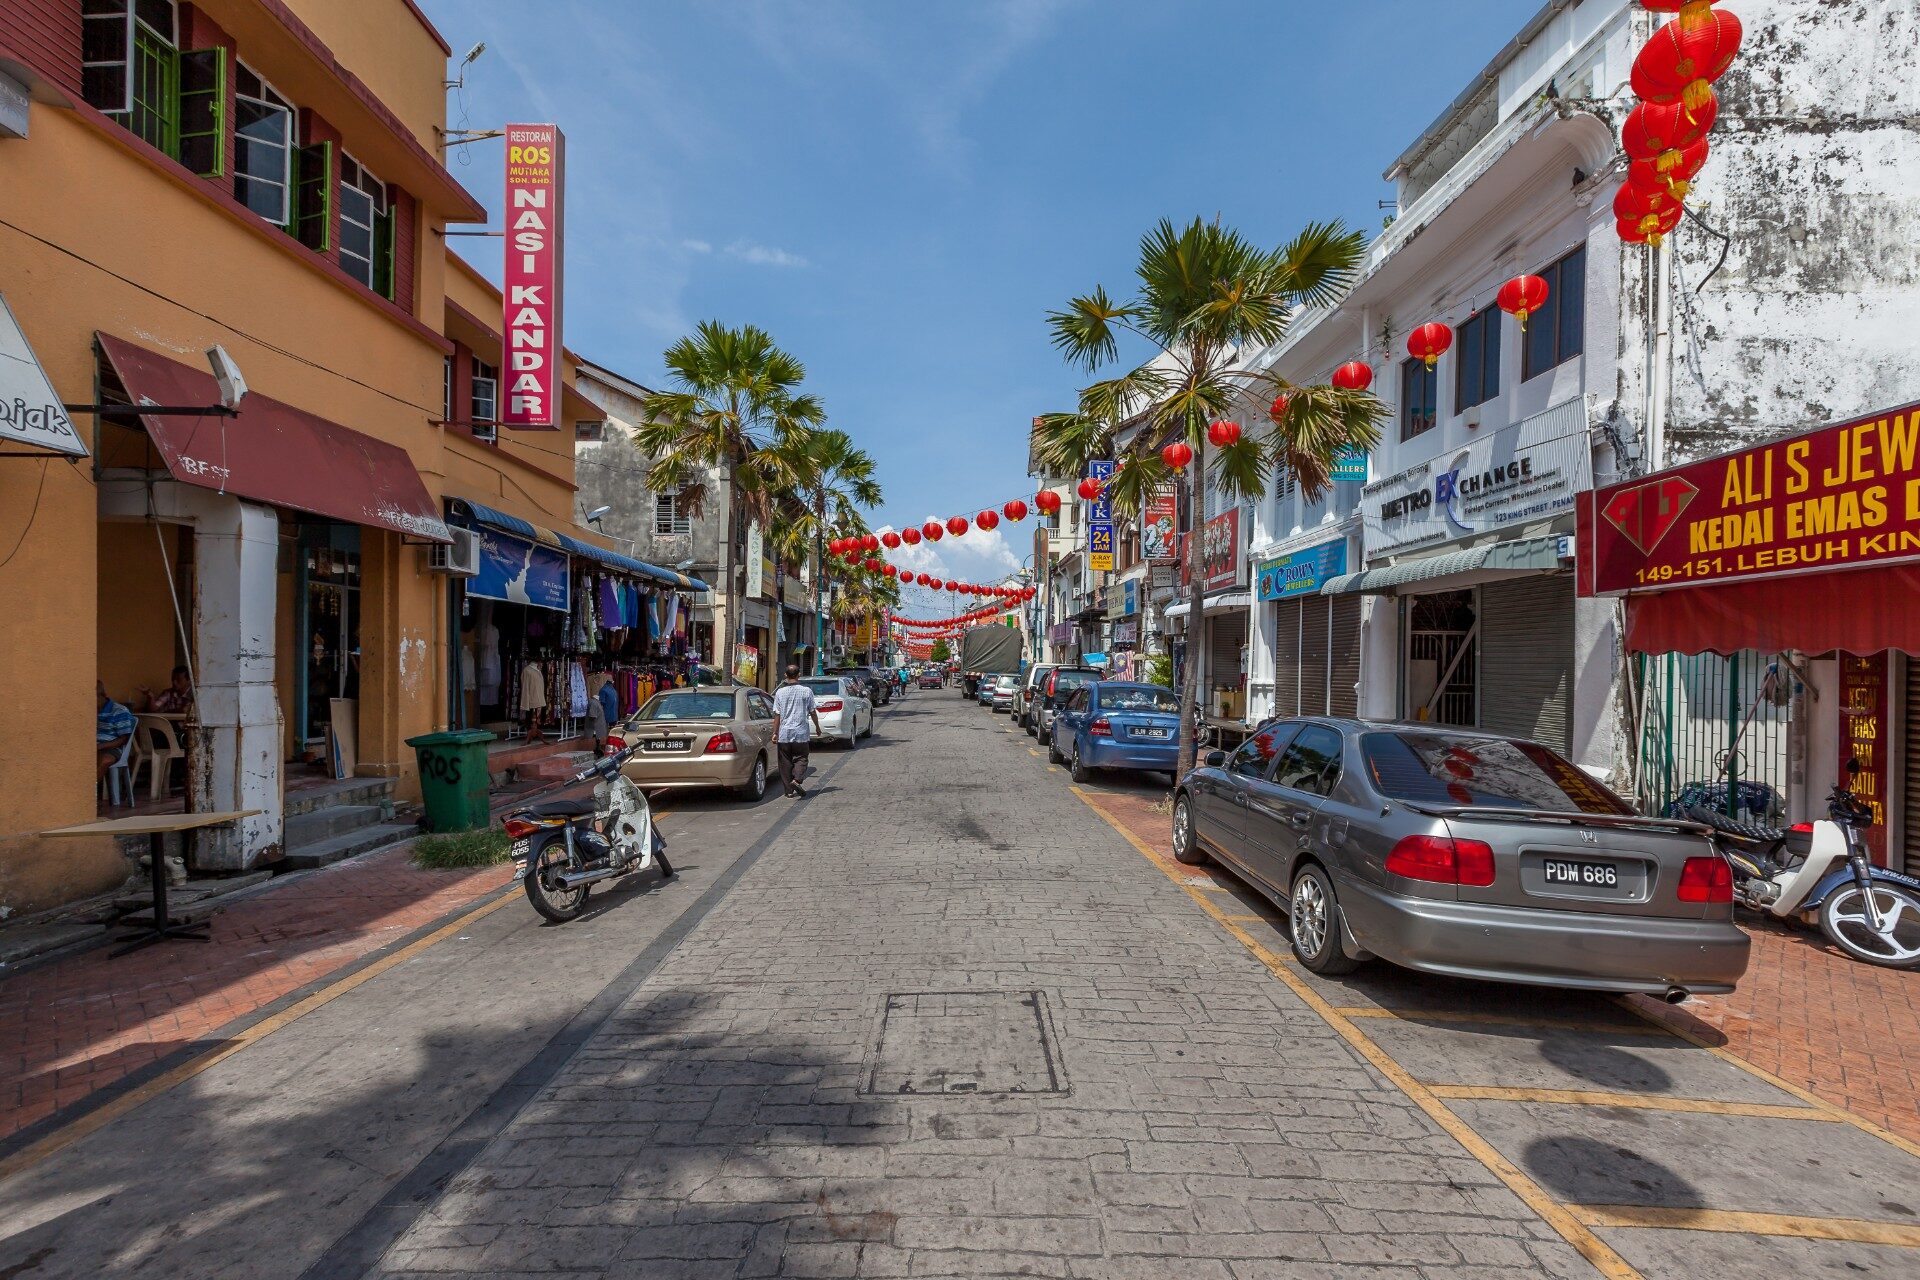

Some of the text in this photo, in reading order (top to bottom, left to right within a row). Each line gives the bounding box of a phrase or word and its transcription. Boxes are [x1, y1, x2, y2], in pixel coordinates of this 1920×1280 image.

[510, 131, 551, 143] RESTORAN
[510, 146, 550, 165] ROS
[510, 167, 550, 176] MUTIARA
[513, 188, 547, 274] NASI
[510, 285, 546, 415] KANDAR
[1721, 410, 1920, 509] ALI S JEW
[1381, 488, 1432, 521] METRO
[1464, 480, 1566, 515] Foreign Currency Wholesale Dealer
[1495, 512, 1507, 523] 123
[1508, 509, 1523, 520] KING
[1689, 507, 1774, 555] KEDAI
[1786, 485, 1888, 541] EMAS
[1093, 531, 1111, 544] 24
[1860, 530, 1920, 556] KIN
[1274, 560, 1315, 595] CROWN
[1848, 715, 1877, 739] EMAS
[650, 741, 684, 749] PGN 3189
[1852, 743, 1873, 767] DAN
[420, 749, 463, 786] ROS
[1545, 861, 1617, 885] PDM 686
